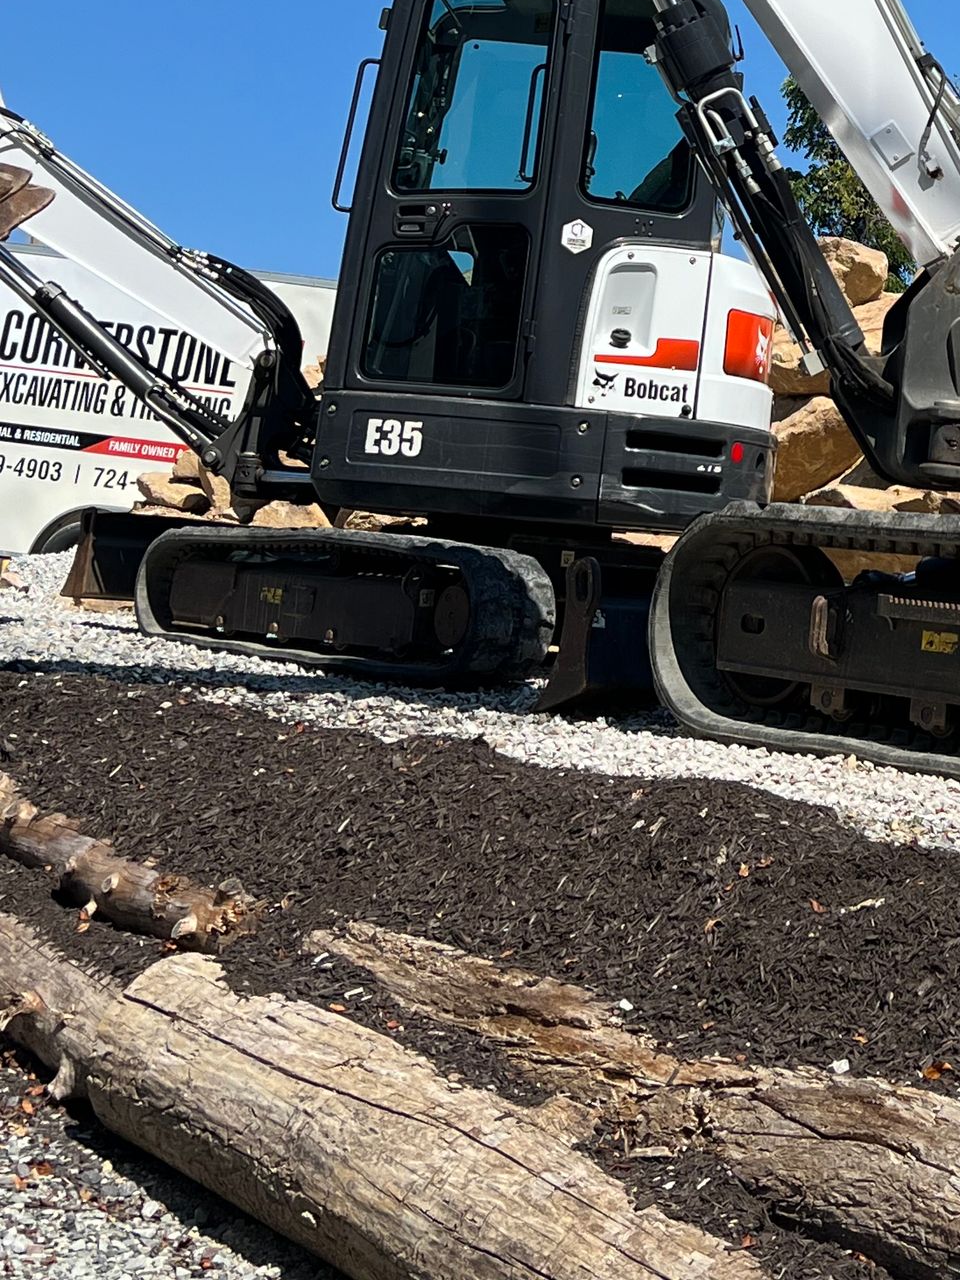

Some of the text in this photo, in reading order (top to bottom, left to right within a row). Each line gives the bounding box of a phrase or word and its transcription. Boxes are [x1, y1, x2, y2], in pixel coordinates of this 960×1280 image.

[0, 309, 237, 388] CORSTONE
[0, 371, 110, 415] XCAVATING
[110, 385, 126, 418] &
[624, 377, 688, 403] Bobcat
[14, 428, 22, 440] &
[23, 429, 81, 447] RESIDENTIAL
[108, 440, 140, 454] FAMILY
[141, 444, 175, 459] OWNED
[364, 418, 423, 458] E35
